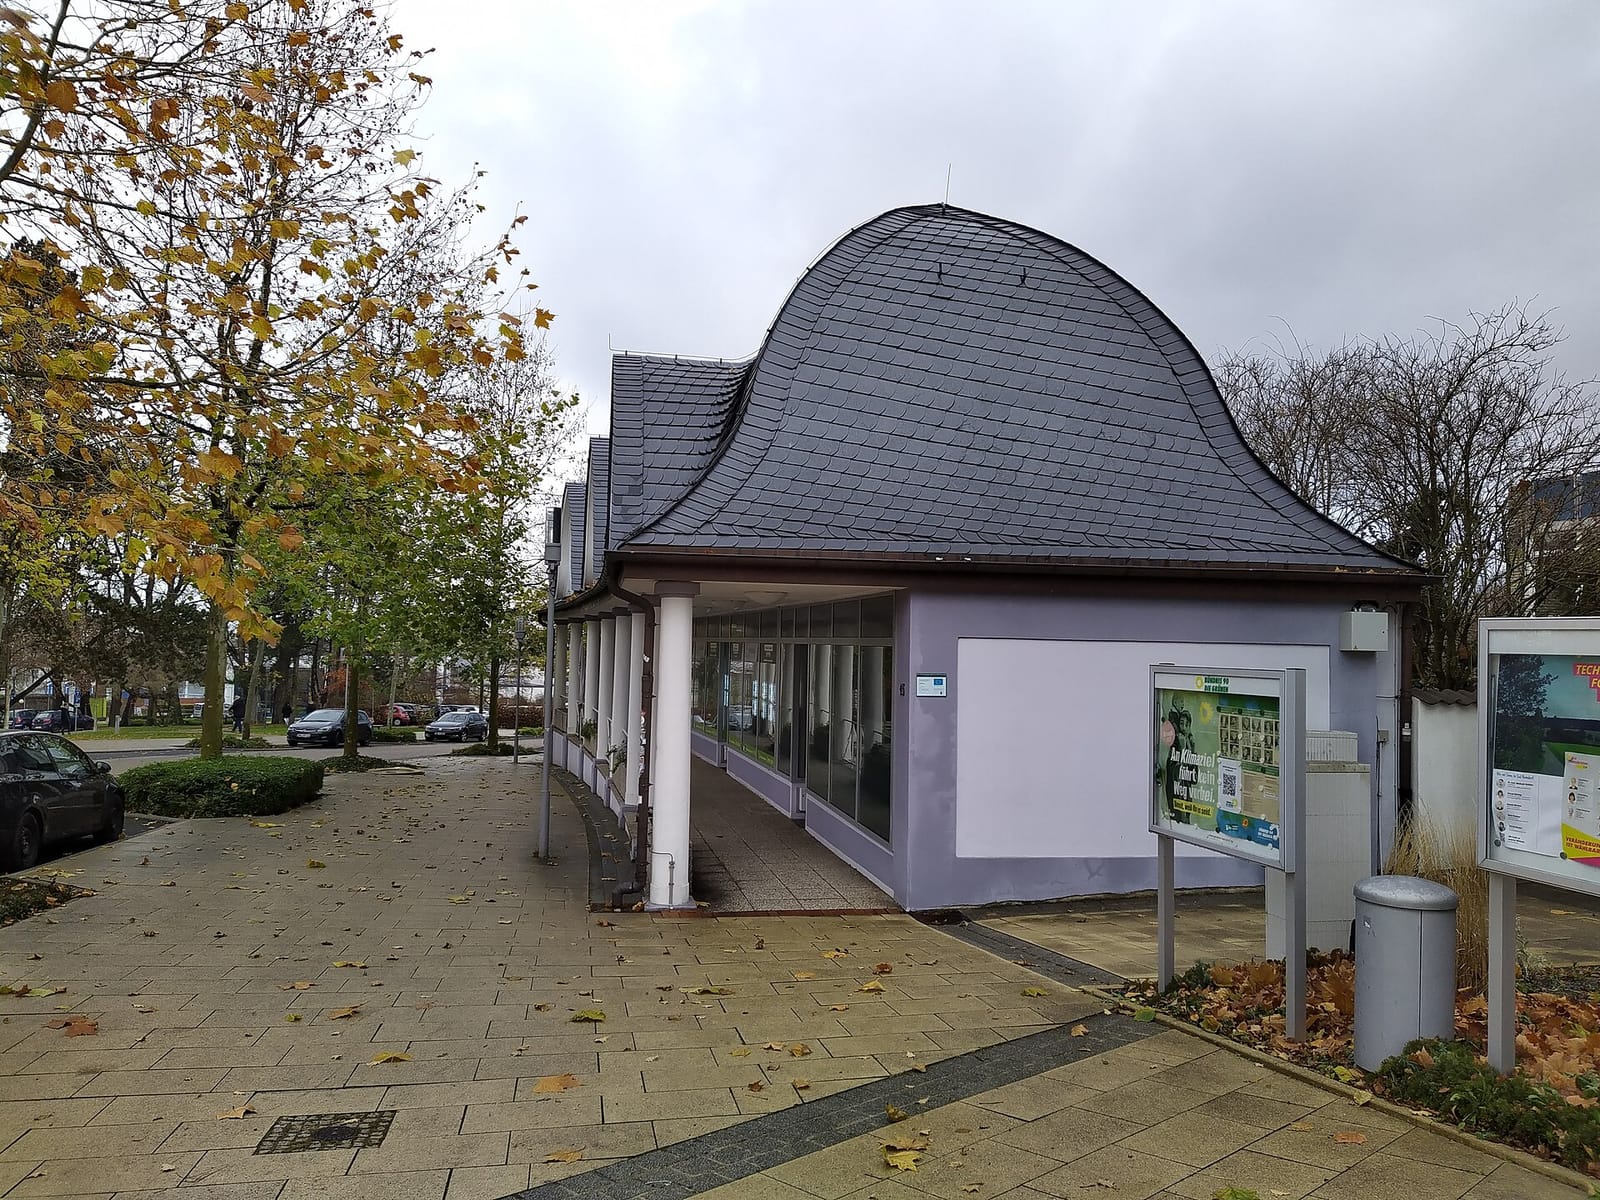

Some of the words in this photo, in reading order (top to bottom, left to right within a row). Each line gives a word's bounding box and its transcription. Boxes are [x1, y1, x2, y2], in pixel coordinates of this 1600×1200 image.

[1170, 747, 1180, 761] An
[1181, 749, 1216, 768] Klimaziel
[1179, 765, 1197, 783] führt
[1197, 766, 1215, 786] kein
[1174, 780, 1188, 800] Weg
